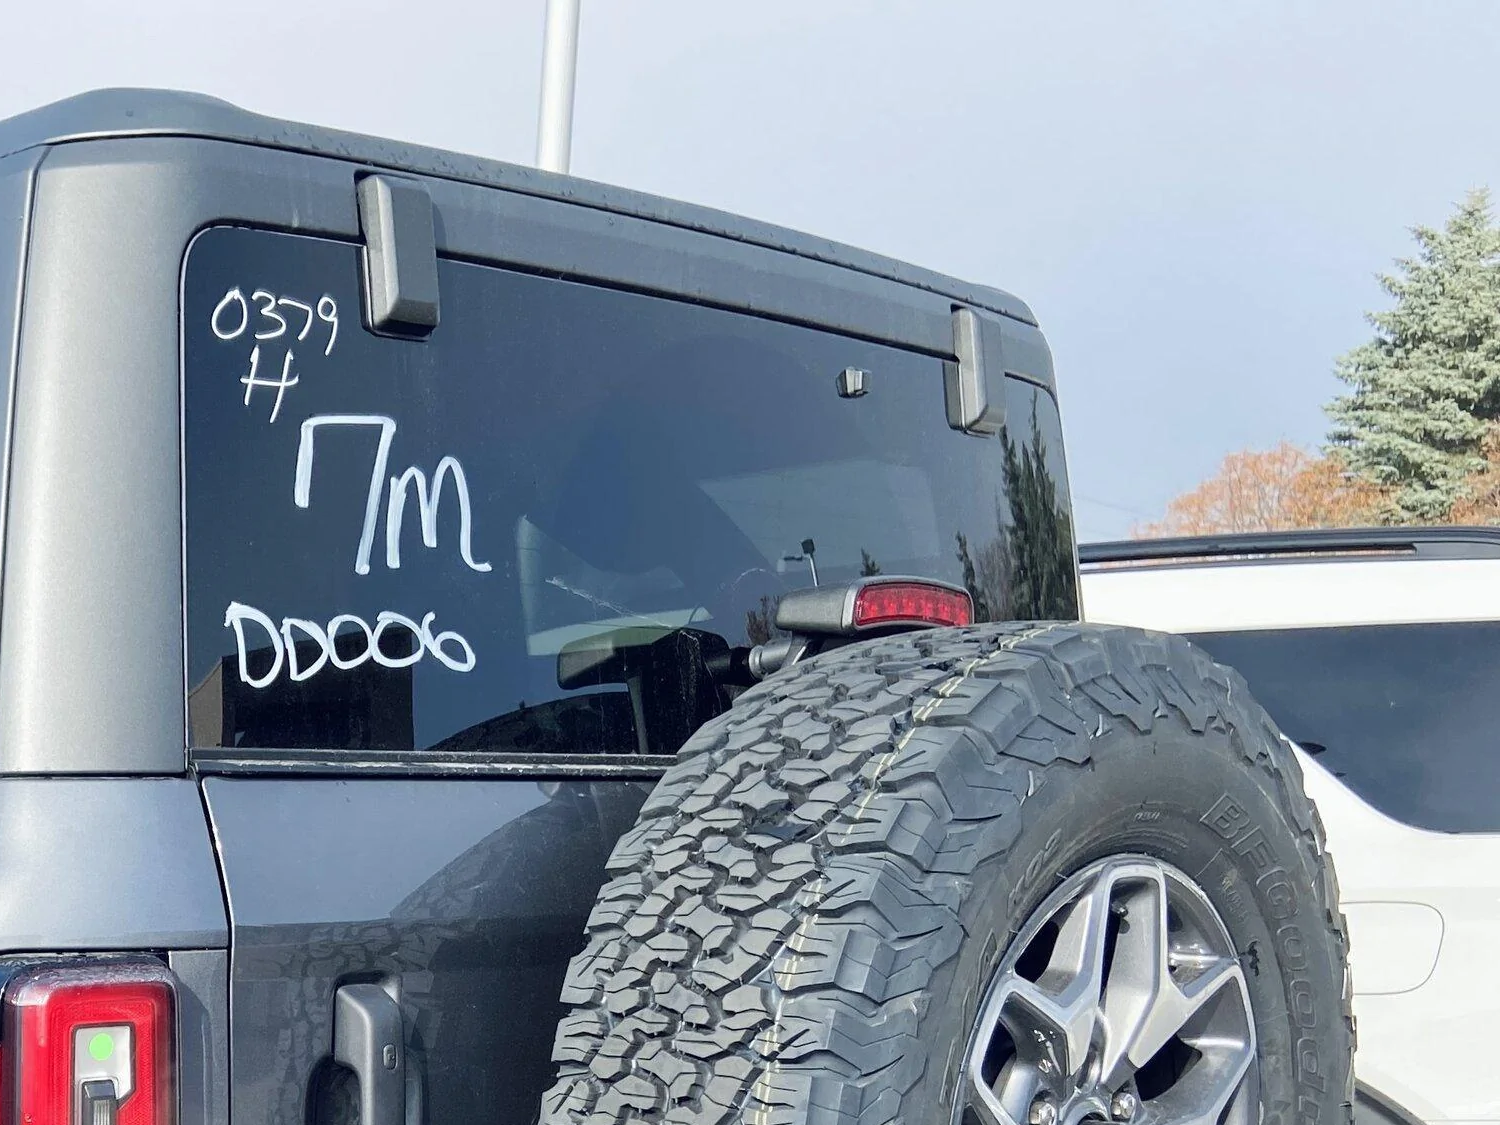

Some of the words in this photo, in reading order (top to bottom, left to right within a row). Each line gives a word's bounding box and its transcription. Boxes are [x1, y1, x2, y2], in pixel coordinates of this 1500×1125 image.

[211, 287, 337, 355] 0379
[241, 345, 299, 423] H
[224, 601, 477, 688] DD006
